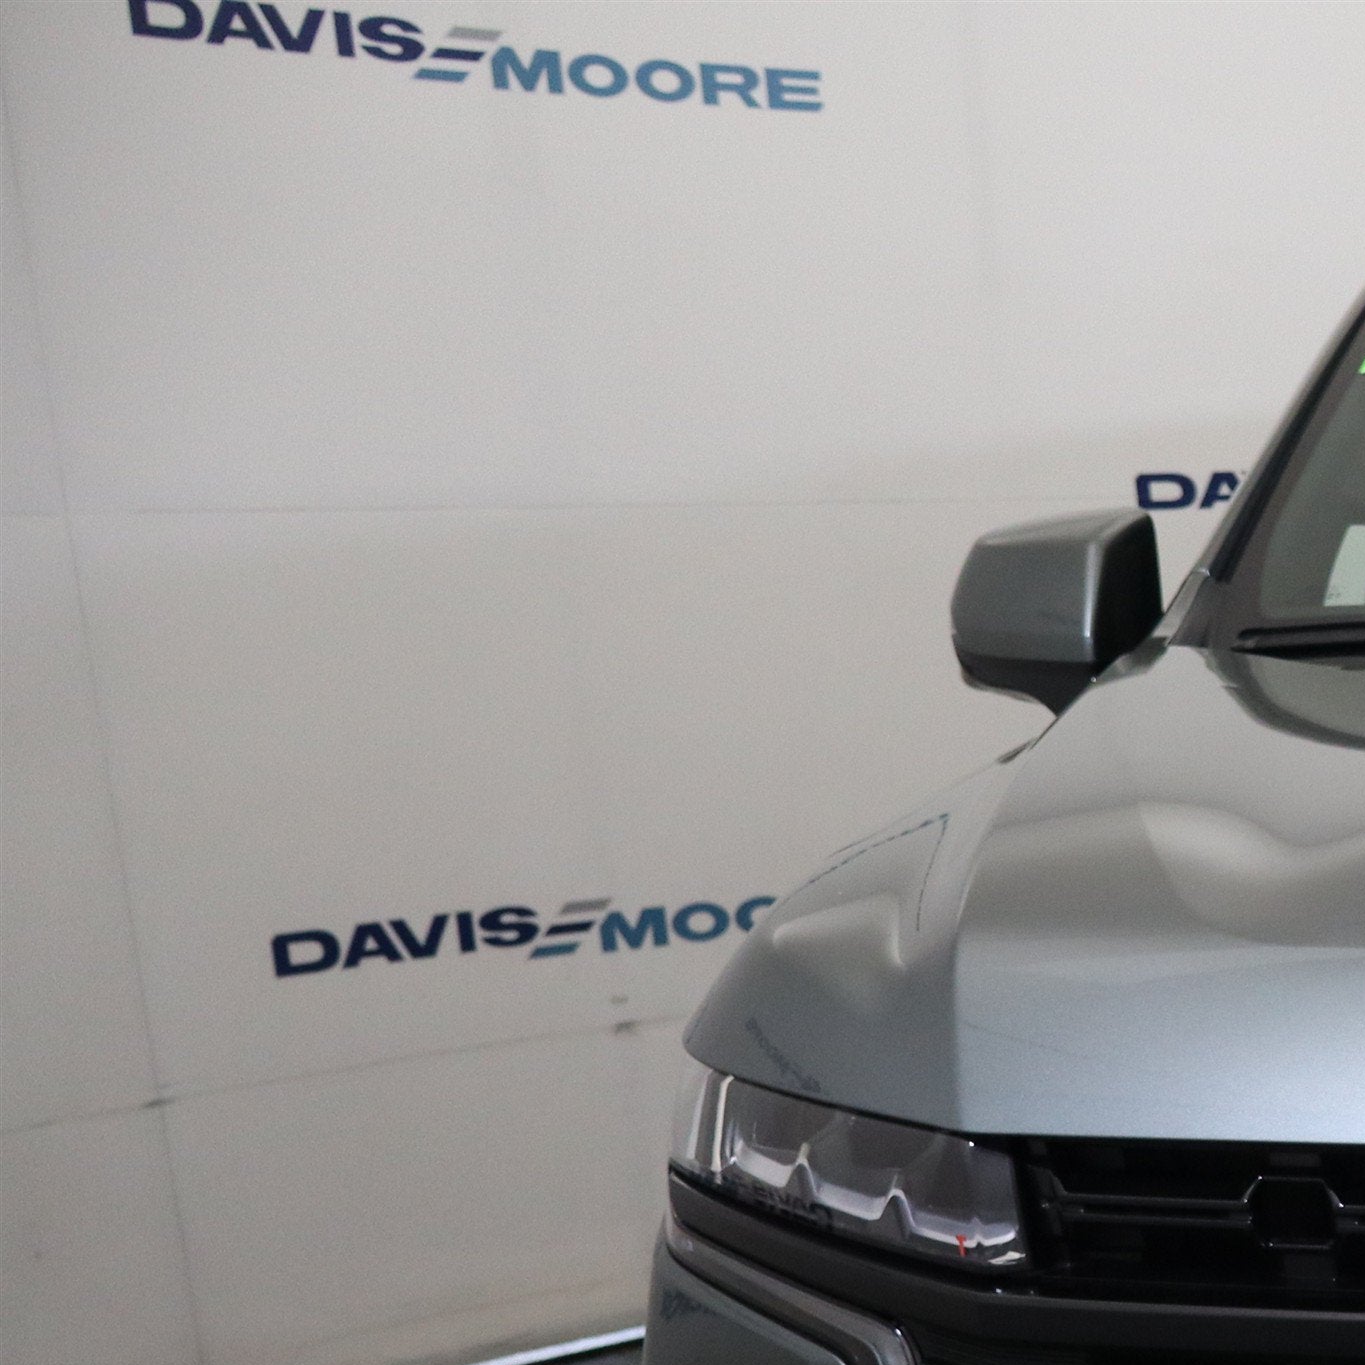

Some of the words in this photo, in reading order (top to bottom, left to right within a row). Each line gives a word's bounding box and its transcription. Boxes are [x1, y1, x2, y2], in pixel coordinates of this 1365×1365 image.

[130, 0, 425, 63] DAVIS
[491, 47, 823, 111] MOORE
[271, 905, 540, 978] DAVIS
